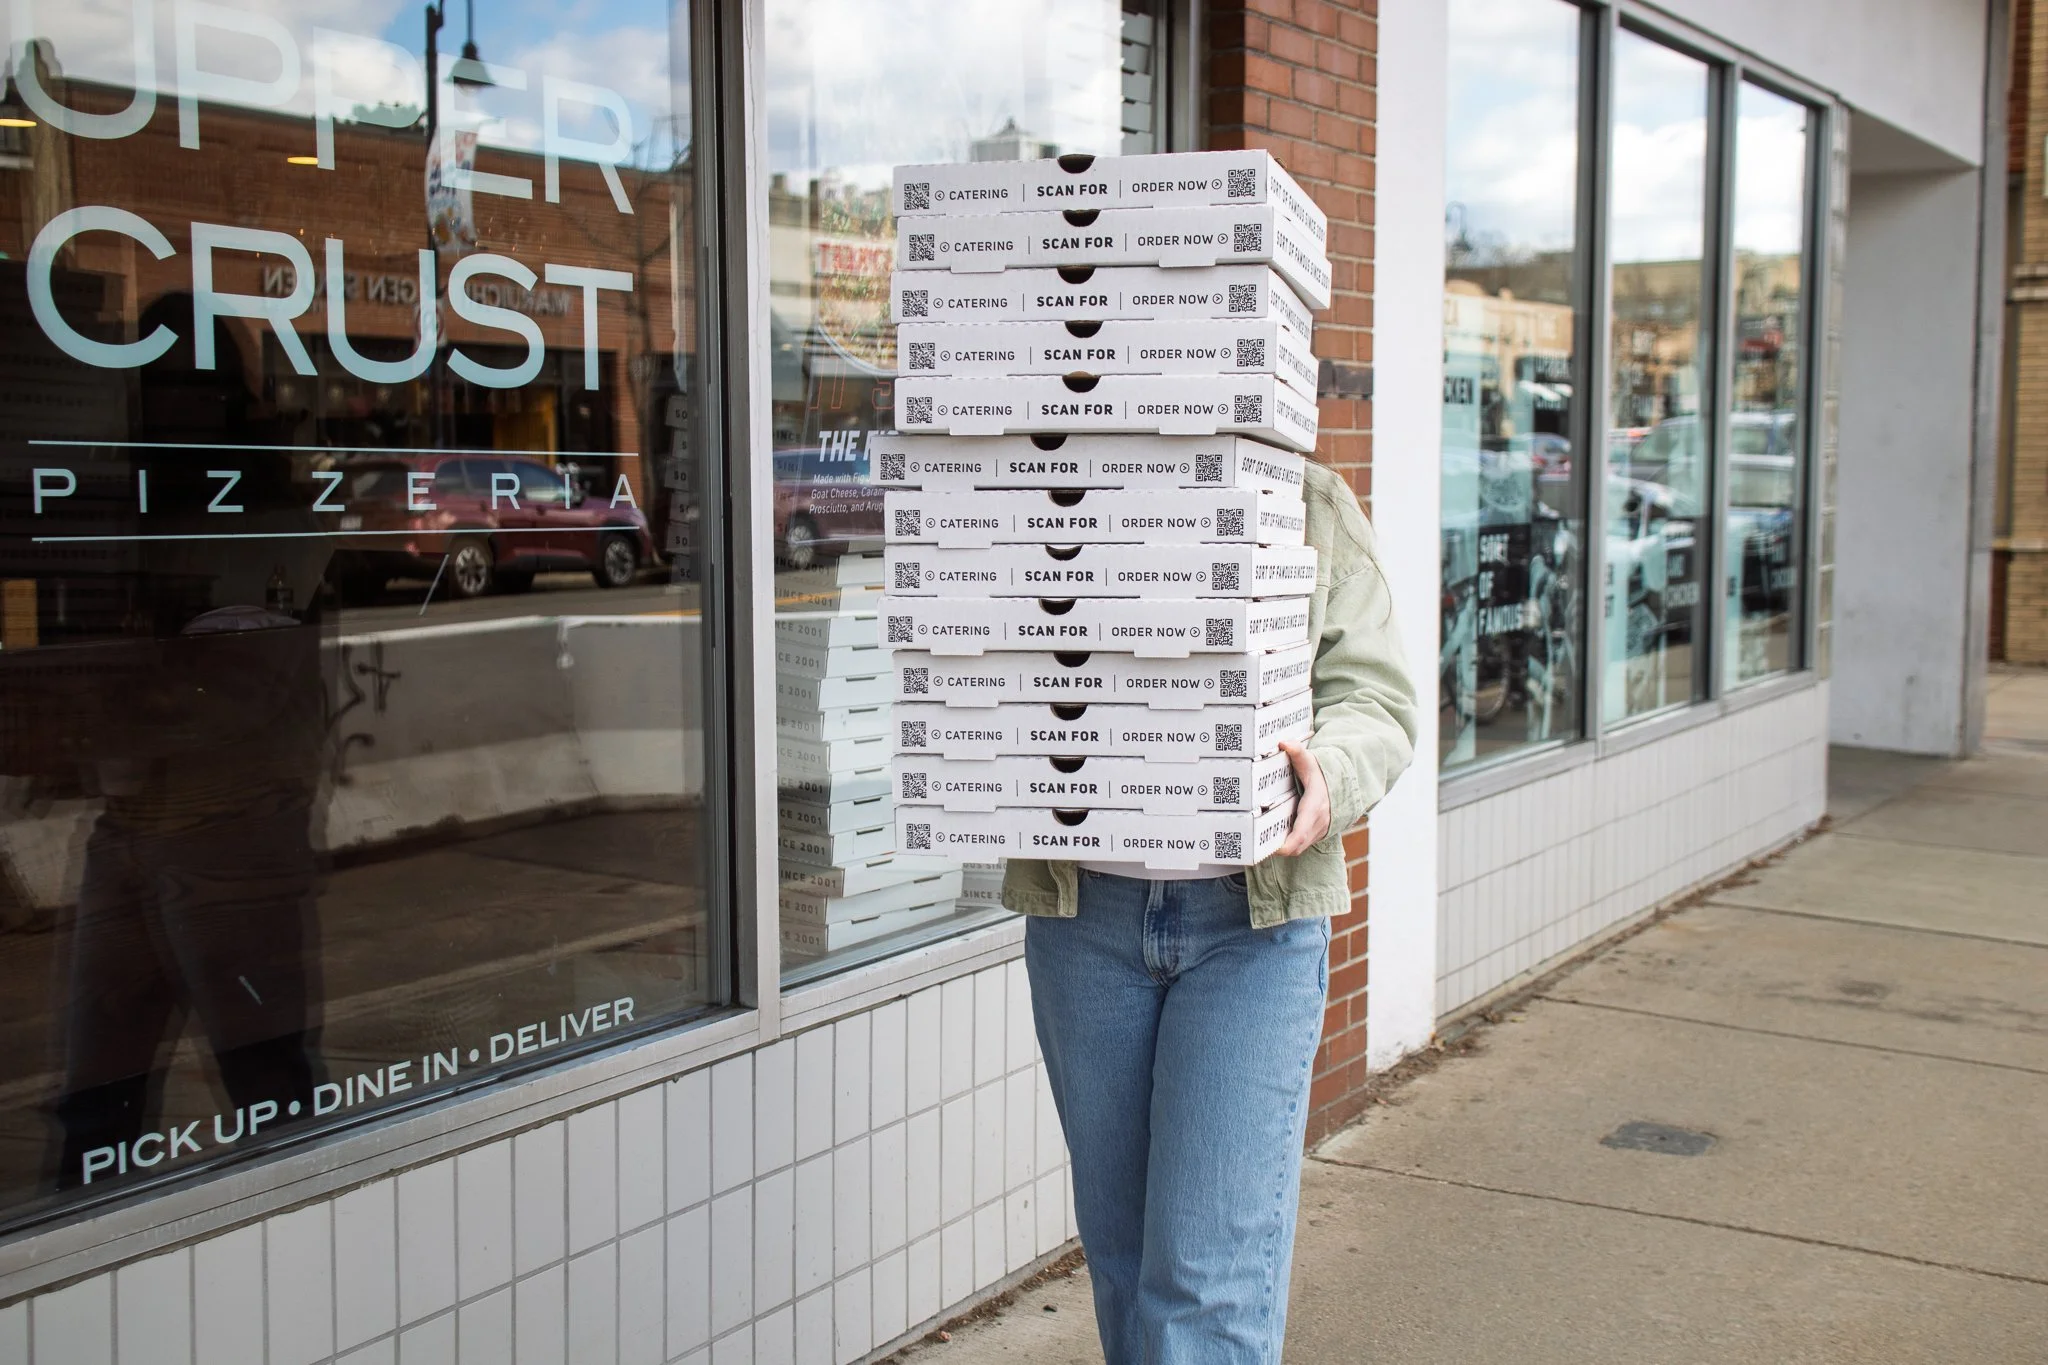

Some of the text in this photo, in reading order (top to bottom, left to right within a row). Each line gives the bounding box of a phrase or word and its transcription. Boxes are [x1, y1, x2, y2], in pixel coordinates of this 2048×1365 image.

[10, 0, 635, 215] UPPER
[950, 180, 1207, 200] CATERING SCAN FOR ORDER NOW
[1271, 176, 1282, 199] SORT
[955, 235, 1213, 252] CATERING SCAN FOR ORDER NOW
[1277, 230, 1288, 252] SORT
[26, 205, 634, 391] CRUST
[948, 295, 1208, 308] CATERING SCAN FOR ORDER NOW
[955, 349, 1216, 361] CATERING SCAN FOR ORDER NOW
[1443, 376, 1474, 404] CKEN
[953, 404, 1214, 415] CATERING SCAN FOR ORDER NOW
[819, 430, 860, 462] THE
[925, 462, 1175, 473] CATERING SCAN FOR ORDER NOW
[1242, 457, 1256, 473] SORT
[1256, 460, 1264, 475] OF
[1262, 463, 1282, 481] FAMOUS
[1282, 468, 1294, 484] SINCE
[814, 474, 833, 484] Made
[835, 472, 851, 484] with
[853, 472, 866, 484] Fig
[33, 467, 639, 514] PIZZERIA
[811, 488, 828, 500] Goat
[831, 488, 859, 500] Cheese,
[809, 501, 884, 515] Prosciutto, and Arug
[941, 518, 1196, 528] CATERING SCAN FOR ORDER NOW
[940, 571, 1192, 582] CATERING SCAN FOR ORDER NOW
[1256, 565, 1268, 580] SORT
[1269, 565, 1276, 580] OF
[1276, 565, 1294, 580] FAMOUS
[1294, 566, 1306, 579] SINCE
[1479, 571, 1494, 600] OF
[808, 593, 833, 608] 2001
[1250, 619, 1262, 634] SORT
[1262, 618, 1269, 632] OF
[1270, 616, 1286, 631] FAMOUS
[1286, 614, 1298, 628] SINCE
[1478, 603, 1524, 634] FAMOUS
[798, 624, 822, 638] 2001
[933, 625, 1186, 637] CATERING SCAN FOR ORDER NOW
[796, 655, 820, 668] 2001
[1262, 670, 1274, 686] SORT
[1274, 668, 1279, 682] OF
[1280, 664, 1294, 680] FAMOUS
[1293, 662, 1302, 676] SINCE
[948, 677, 1200, 688] CATERING SCAN FOR ORDER NOW
[788, 686, 812, 700] 2001
[792, 719, 816, 734] 2001
[1259, 722, 1270, 739] SORT
[1270, 720, 1276, 734] OF
[1277, 713, 1292, 729] FAMOUS
[1292, 708, 1302, 724] SINCE
[946, 731, 1195, 742] CATERING SCAN FOR ORDER NOW
[798, 750, 822, 764] 2001
[798, 780, 823, 794] 2001
[1258, 773, 1271, 792] SORT
[1271, 770, 1278, 785] OF
[946, 783, 1193, 795] CATERING SCAN FOR ORDER NOW
[798, 812, 822, 826] 2001
[950, 834, 1195, 849] CATERING SCAN FOR ORDER NOW
[1260, 825, 1272, 846] SORT
[1273, 822, 1280, 837] OF
[800, 842, 826, 856] 2001
[780, 870, 836, 889] INCE 2001
[963, 890, 992, 899] SINCE
[795, 902, 818, 916] 2001
[795, 930, 820, 946] 2001
[82, 996, 636, 1184] PICK UP DINE IN DELIVER
